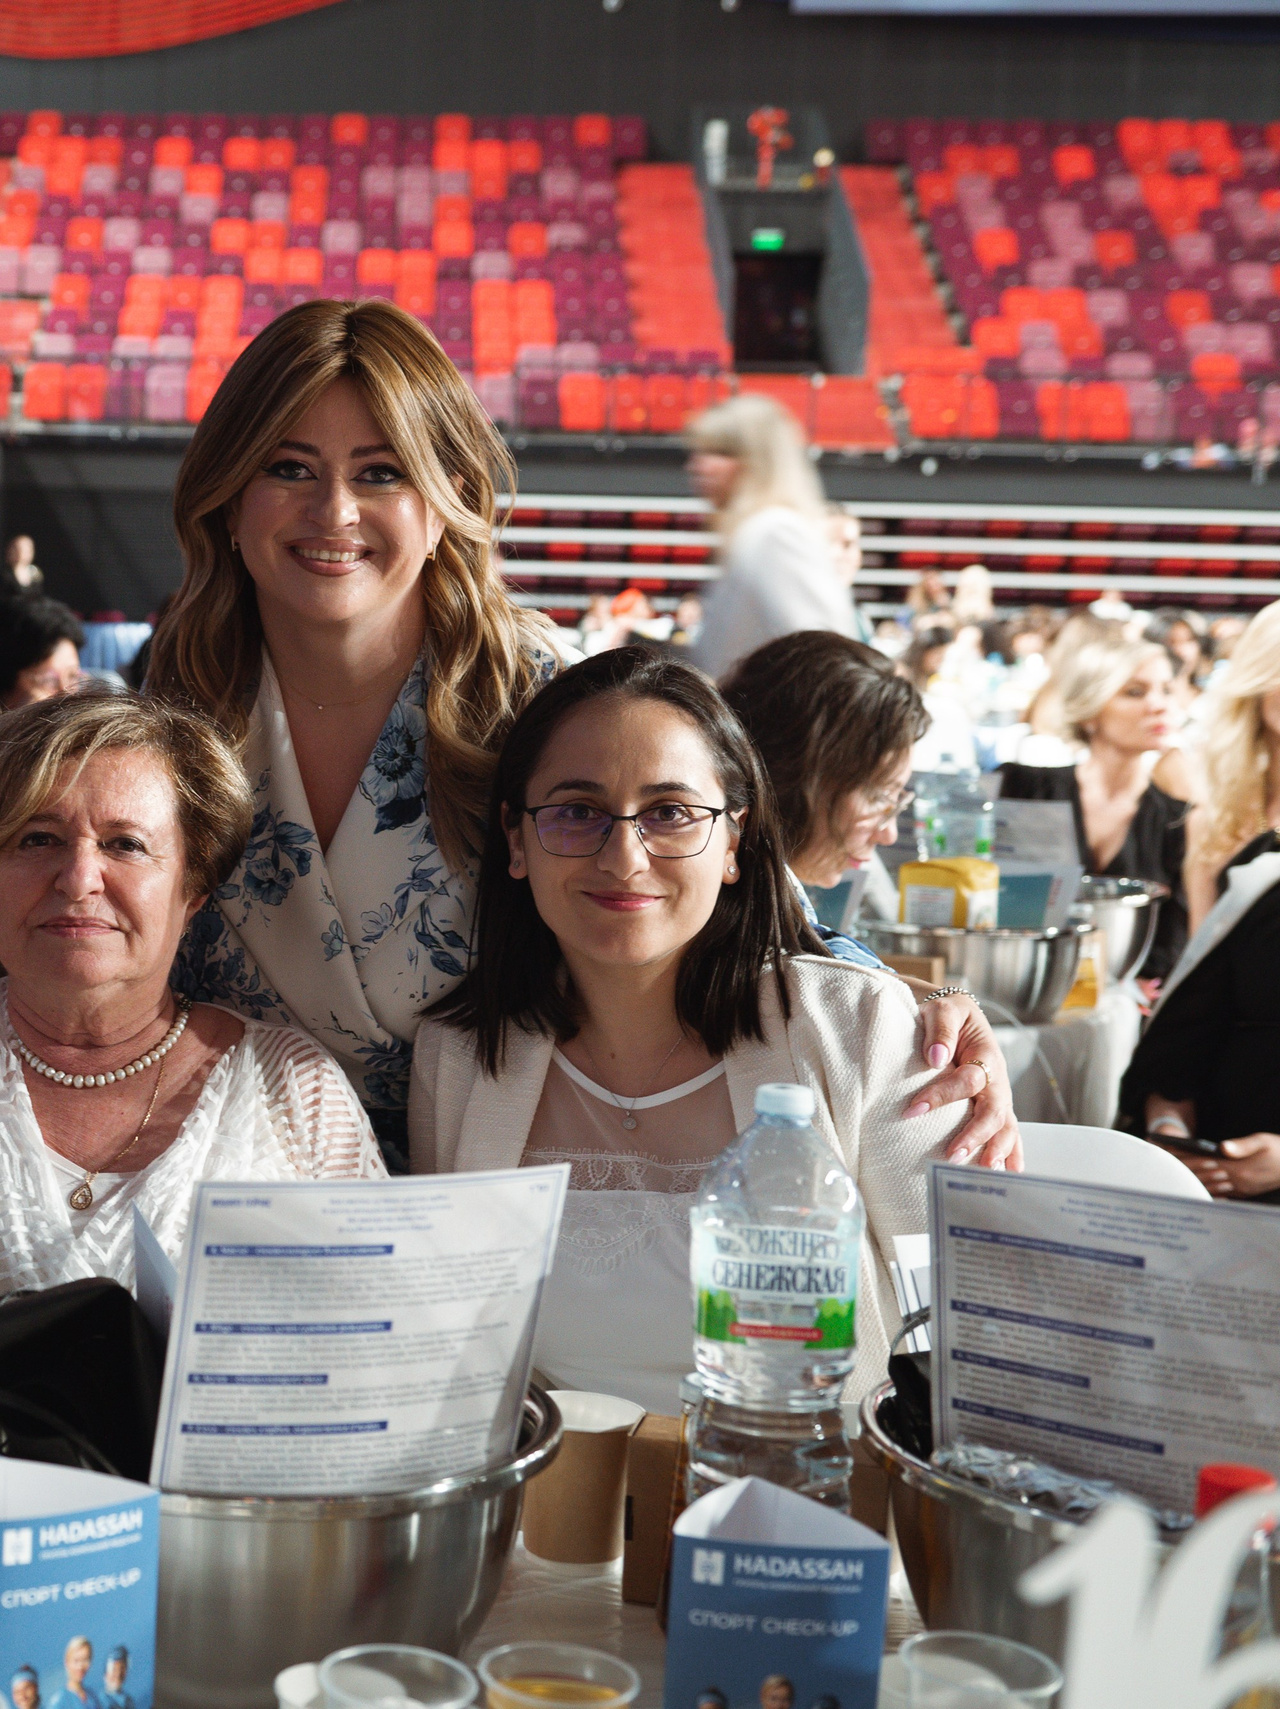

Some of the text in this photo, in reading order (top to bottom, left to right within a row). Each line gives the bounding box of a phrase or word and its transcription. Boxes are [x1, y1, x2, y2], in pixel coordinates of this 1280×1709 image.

[712, 1260, 846, 1293] СЕНЕЖСКАЯ
[39, 1508, 143, 1547] HADASSAH
[734, 1554, 864, 1580] HADASSAH
[1, 1567, 141, 1608] СПОРТ CHECK-UP
[689, 1608, 860, 1637] СПОРТ CHECK-UP
